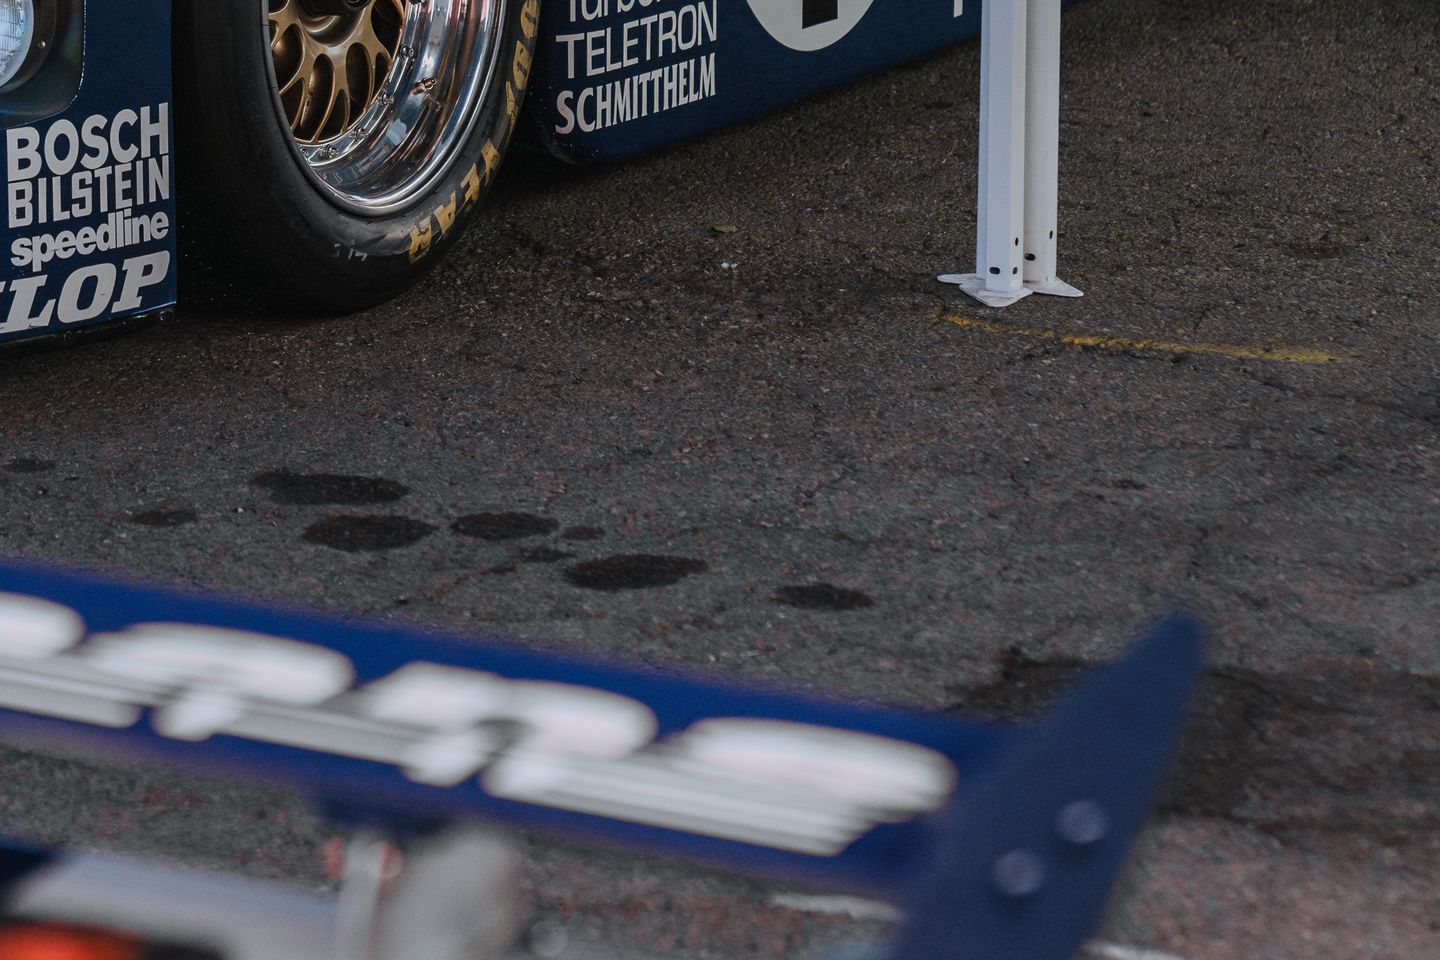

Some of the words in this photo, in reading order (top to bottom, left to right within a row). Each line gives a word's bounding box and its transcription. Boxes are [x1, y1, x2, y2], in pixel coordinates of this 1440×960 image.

[555, 52, 716, 138] SCHMITTHELM
[6, 102, 169, 182] BOSCH
[8, 155, 170, 229] BILSTEIN
[10, 208, 169, 273] speedline
